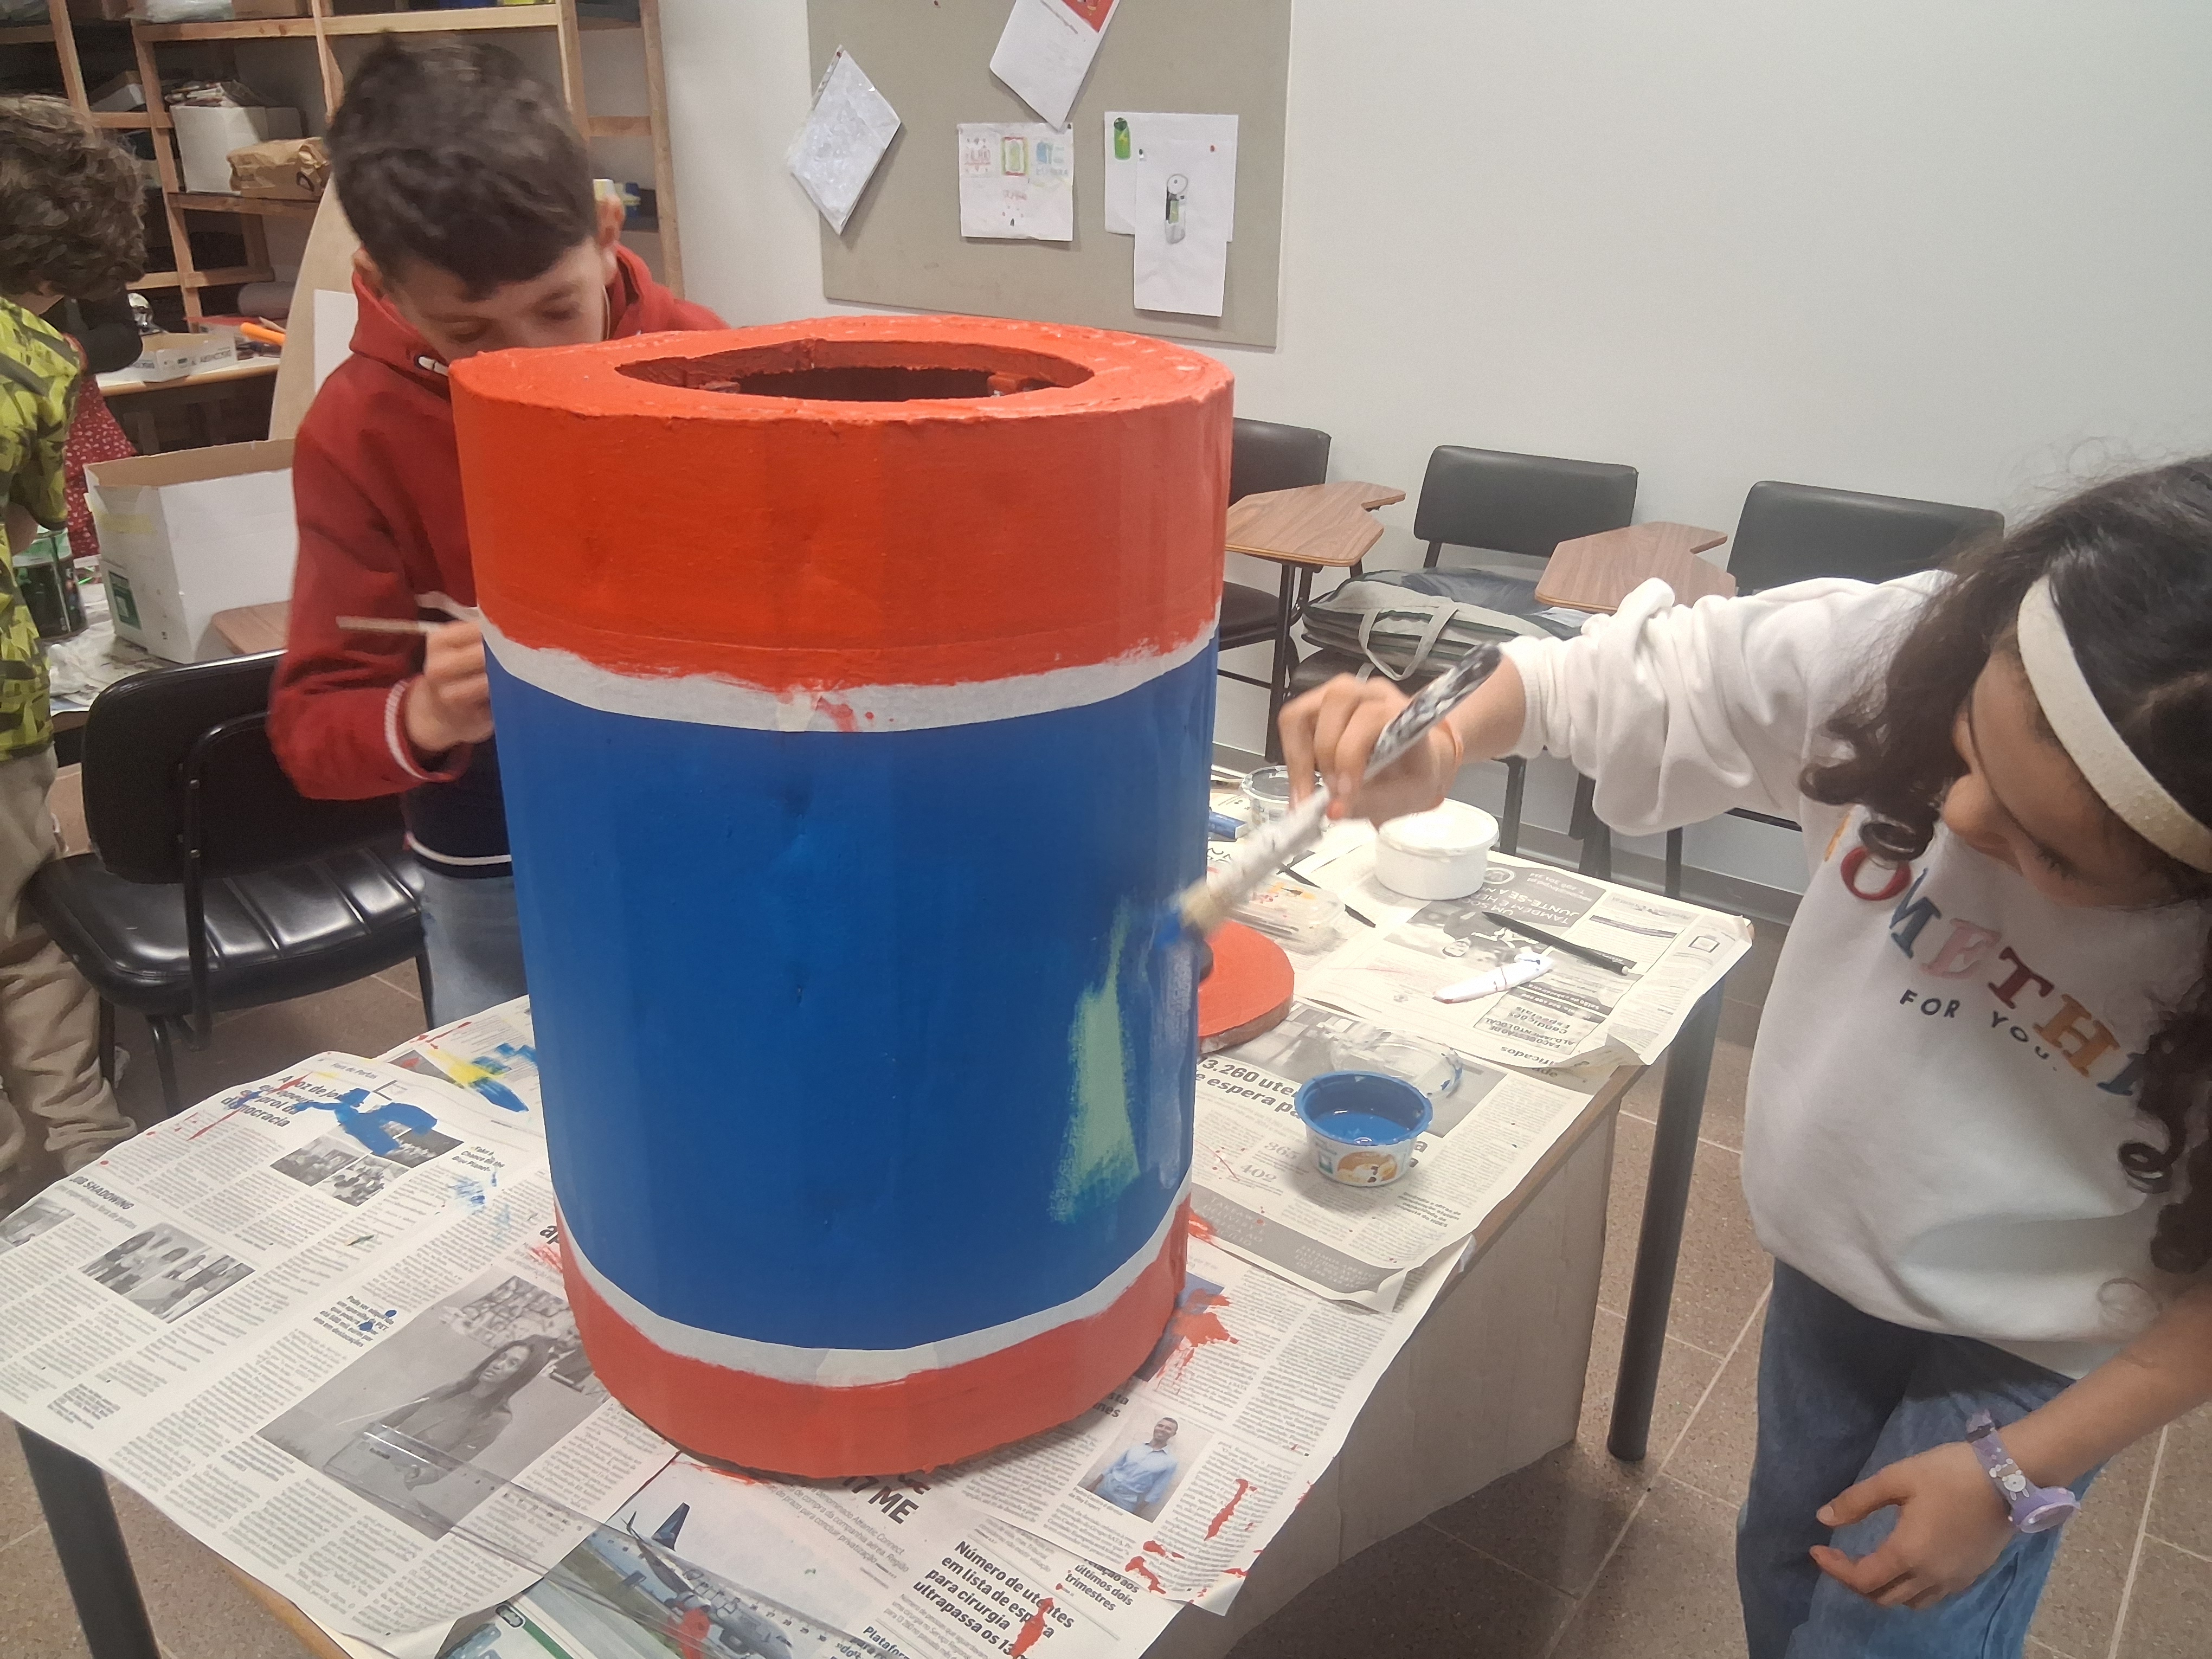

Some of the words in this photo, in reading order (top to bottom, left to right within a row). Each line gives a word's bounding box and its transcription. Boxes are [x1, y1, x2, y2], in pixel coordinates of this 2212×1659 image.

[1509, 890, 1580, 917] JUNTE-SE
[1899, 988, 1960, 1019] FOR
[279, 1075, 294, 1083] A
[309, 1084, 325, 1095] de
[1206, 1078, 1276, 1107] espera
[1239, 1163, 1277, 1183] 402
[83, 1181, 134, 1210] SHADOWING
[876, 1532, 905, 1555] Connect
[941, 1557, 964, 1576] em
[961, 1568, 993, 1595] lista
[991, 1590, 1010, 1607] de
[954, 1540, 1006, 1581] Número
[1004, 1577, 1024, 1593] de
[924, 1569, 959, 1595] para
[957, 1590, 1011, 1631] cirurgia
[1065, 1573, 1116, 1611] trimestres
[1075, 1564, 1113, 1592] últimos
[1110, 1588, 1134, 1606] dois
[912, 1581, 983, 1634] ultrapassa
[981, 1628, 1001, 1645] os
